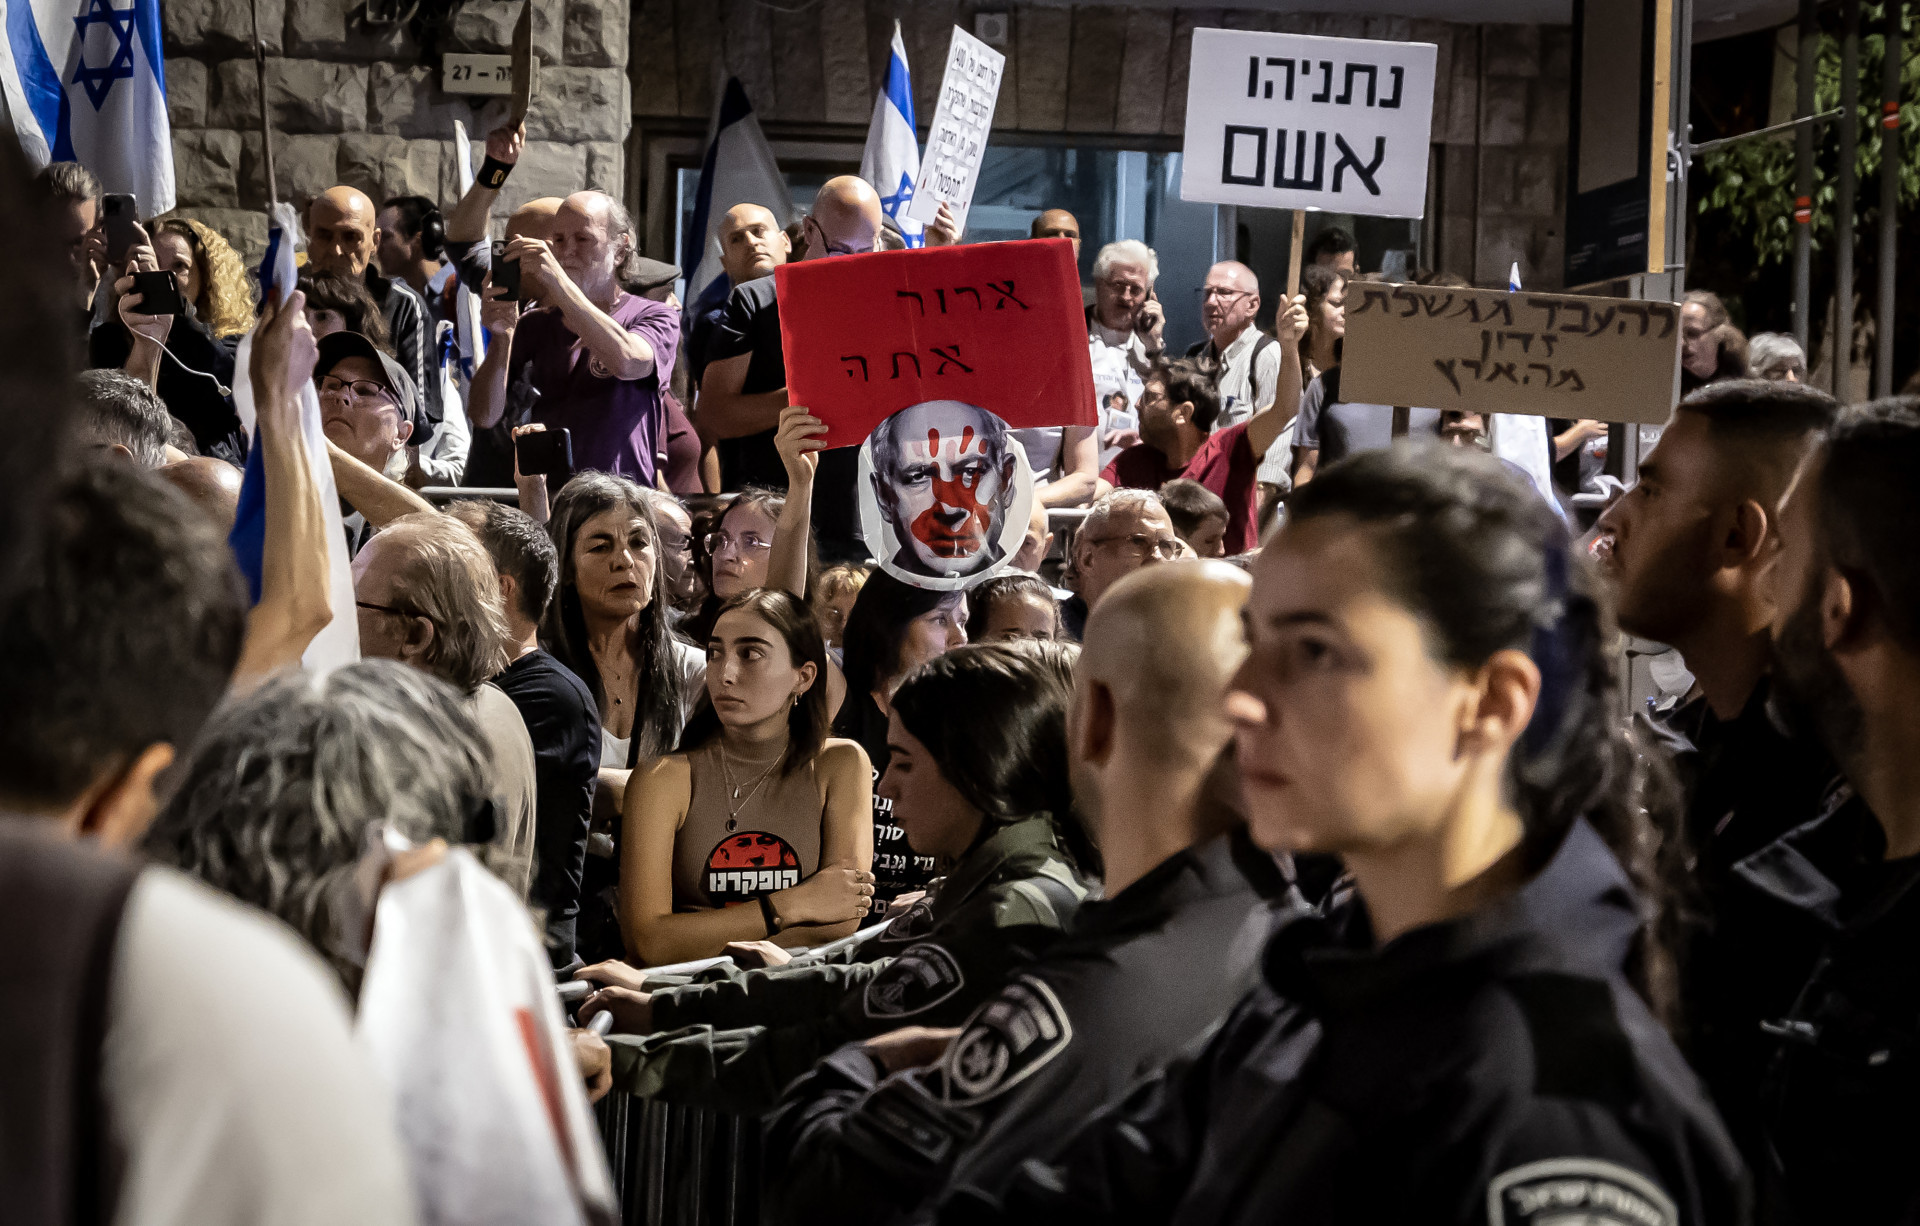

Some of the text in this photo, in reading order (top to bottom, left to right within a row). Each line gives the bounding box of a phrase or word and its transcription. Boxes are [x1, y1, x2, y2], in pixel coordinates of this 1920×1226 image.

[452, 64, 472, 80] 27
[1247, 56, 1404, 109] נתניהו
[1222, 123, 1386, 196] אשם
[897, 280, 1029, 317] ארור
[840, 345, 973, 382] אתה
[1433, 358, 1586, 396] מהארץ
[709, 869, 799, 895] הופקרנו
